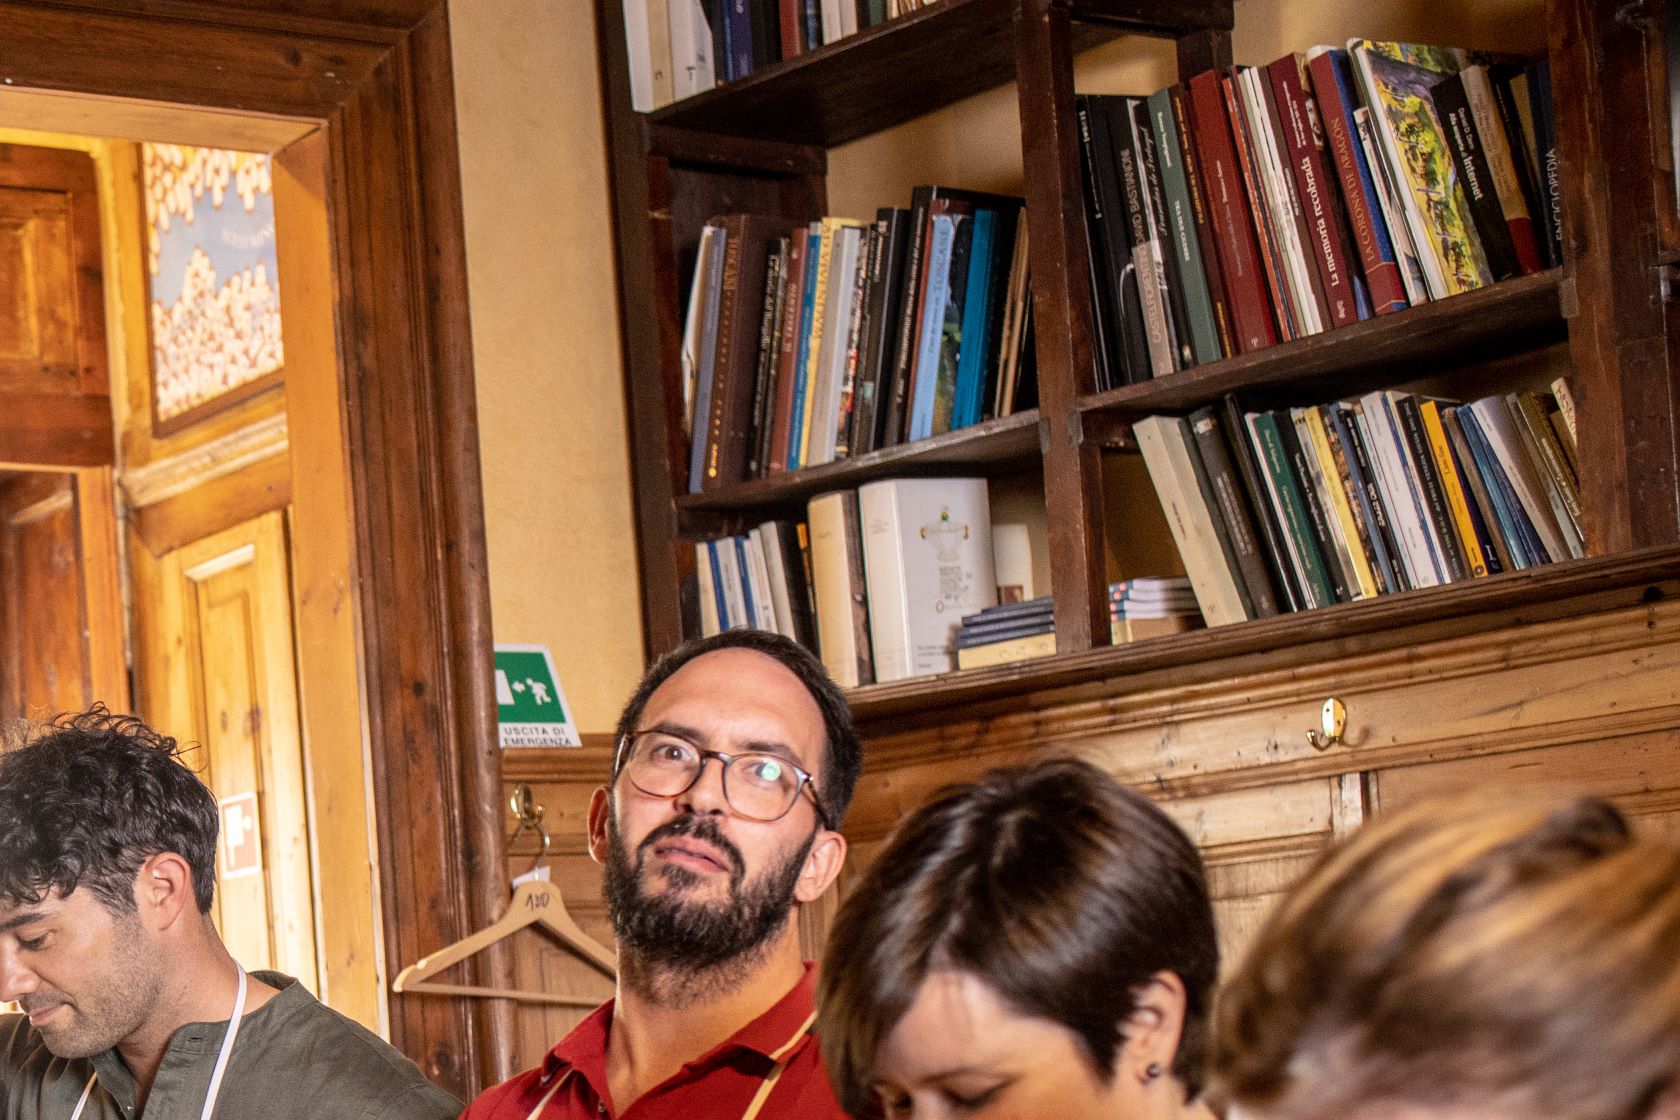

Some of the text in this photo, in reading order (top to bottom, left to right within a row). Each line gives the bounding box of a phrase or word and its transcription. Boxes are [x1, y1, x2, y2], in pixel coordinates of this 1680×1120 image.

[1345, 172, 1357, 189] DE
[1462, 155, 1484, 201] Internet
[1301, 156, 1341, 287] La memoria recobrada
[1351, 191, 1371, 244] CORONA
[1364, 244, 1376, 261] LA
[504, 727, 565, 736] USCITA DI
[504, 737, 572, 745] EMERGENZA
